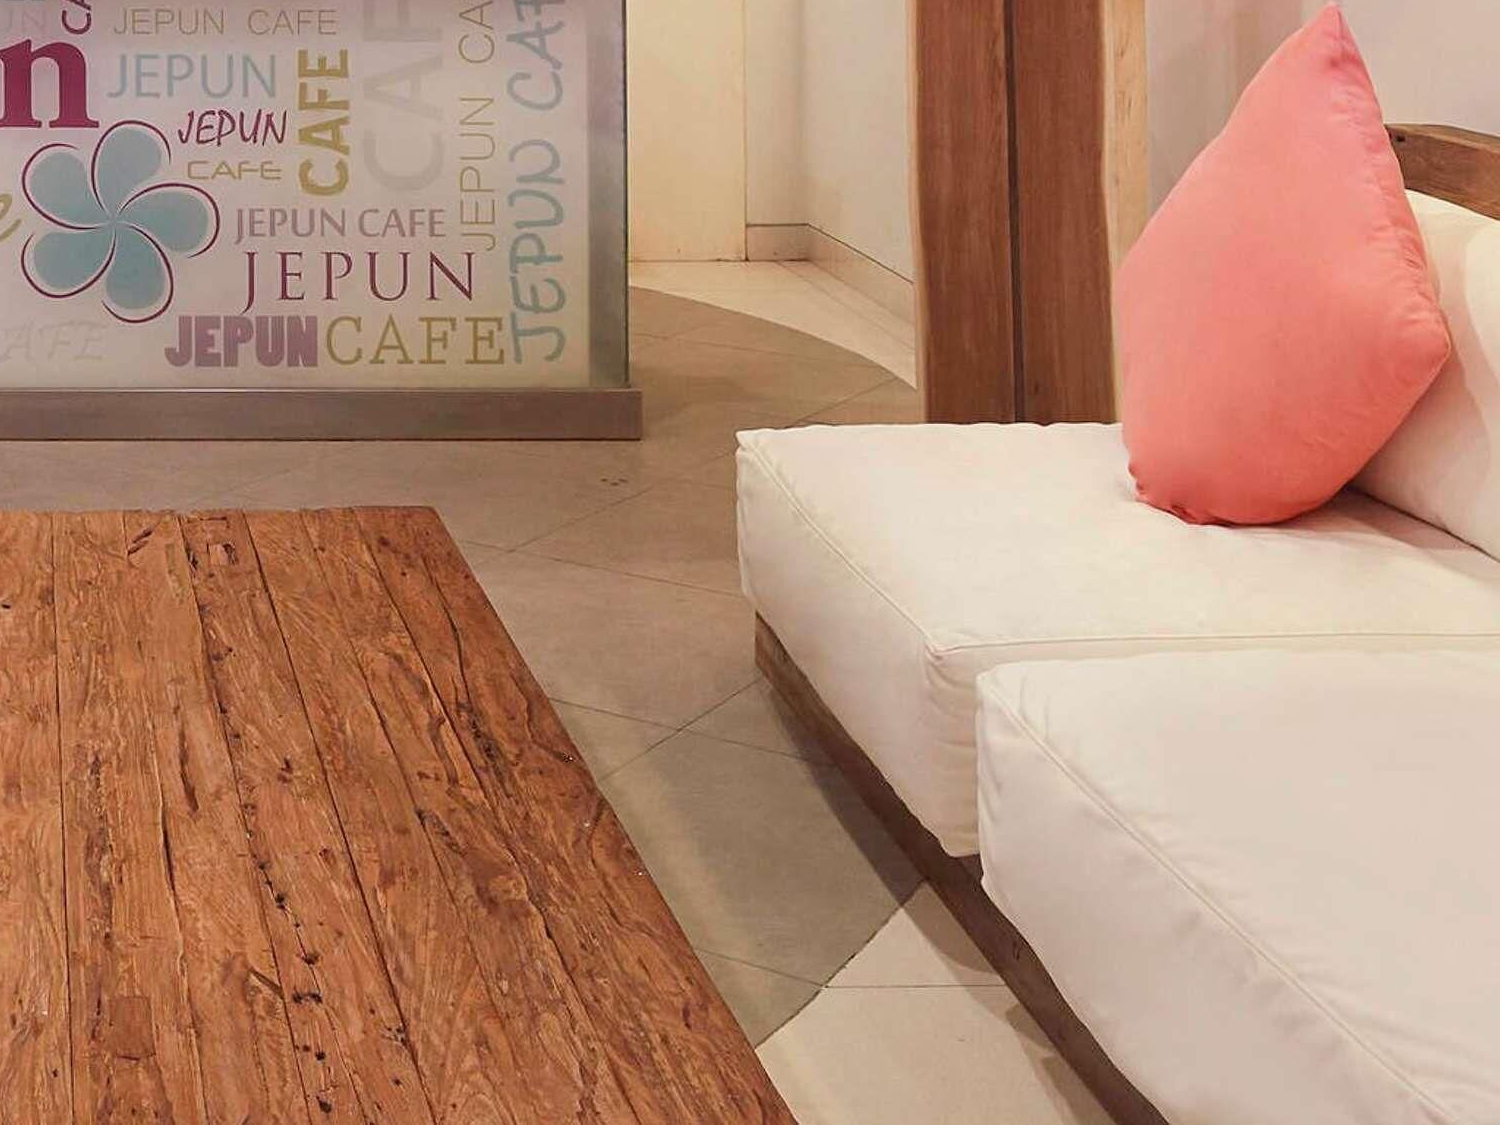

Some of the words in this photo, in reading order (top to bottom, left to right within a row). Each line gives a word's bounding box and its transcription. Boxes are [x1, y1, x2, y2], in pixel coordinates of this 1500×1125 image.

[113, 9, 225, 36] JEPUN
[247, 9, 337, 36] CAFE
[107, 53, 277, 99] JEPUN
[178, 109, 287, 147] JEPUN
[297, 48, 350, 197] CAFE
[187, 160, 282, 180] CAFE
[459, 96, 496, 252] JEPUN
[235, 208, 345, 245] JEPUN
[358, 209, 446, 237] CAFE
[240, 251, 476, 314] JEPUN
[164, 316, 319, 368] JEPUN
[325, 315, 505, 366] CAFE
